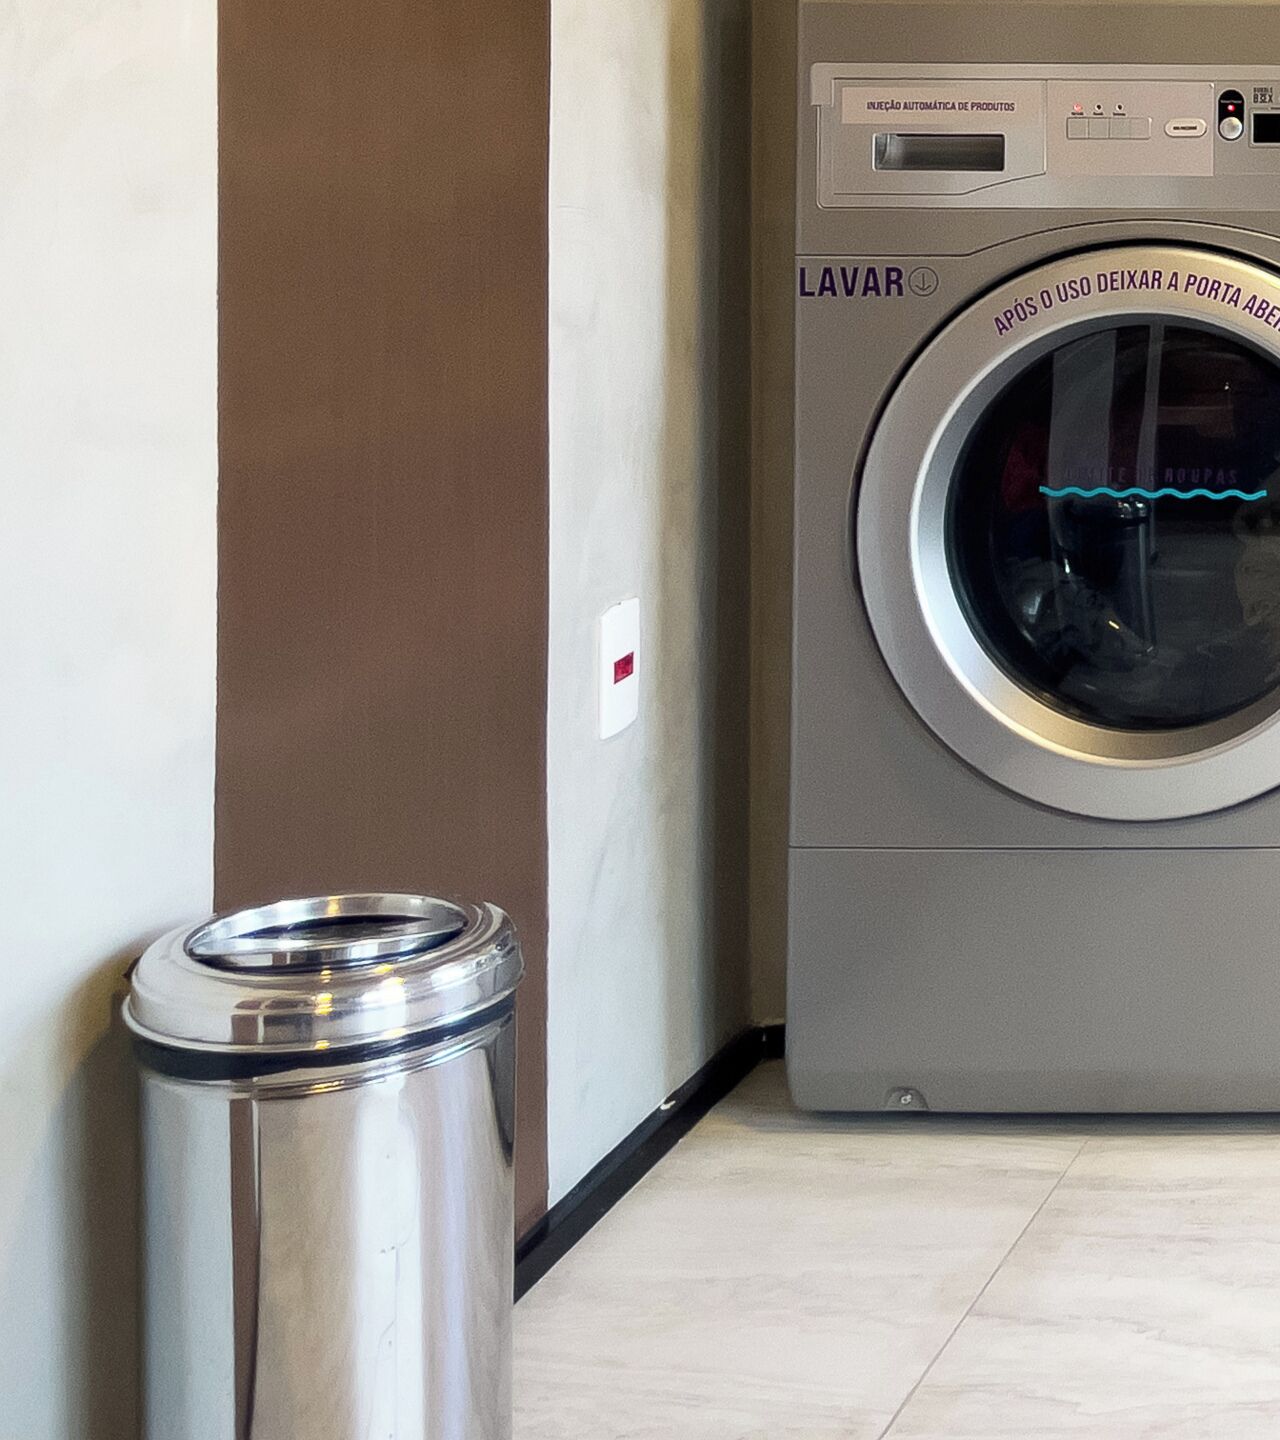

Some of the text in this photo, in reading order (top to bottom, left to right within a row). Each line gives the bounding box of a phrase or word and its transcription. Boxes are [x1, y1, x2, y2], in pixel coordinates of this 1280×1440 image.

[867, 100, 1015, 112] INJEÇÃO AUTOMÁTICA DE PRODUTOS
[800, 267, 903, 296] LAVAR
[993, 297, 1038, 335] APÓS
[1040, 290, 1053, 309] O
[1056, 276, 1091, 303] USO
[1097, 270, 1162, 293] DEIXAR
[1167, 271, 1179, 291] A
[1184, 273, 1243, 308] PORTA
[1164, 467, 1238, 485] ROUPAS
